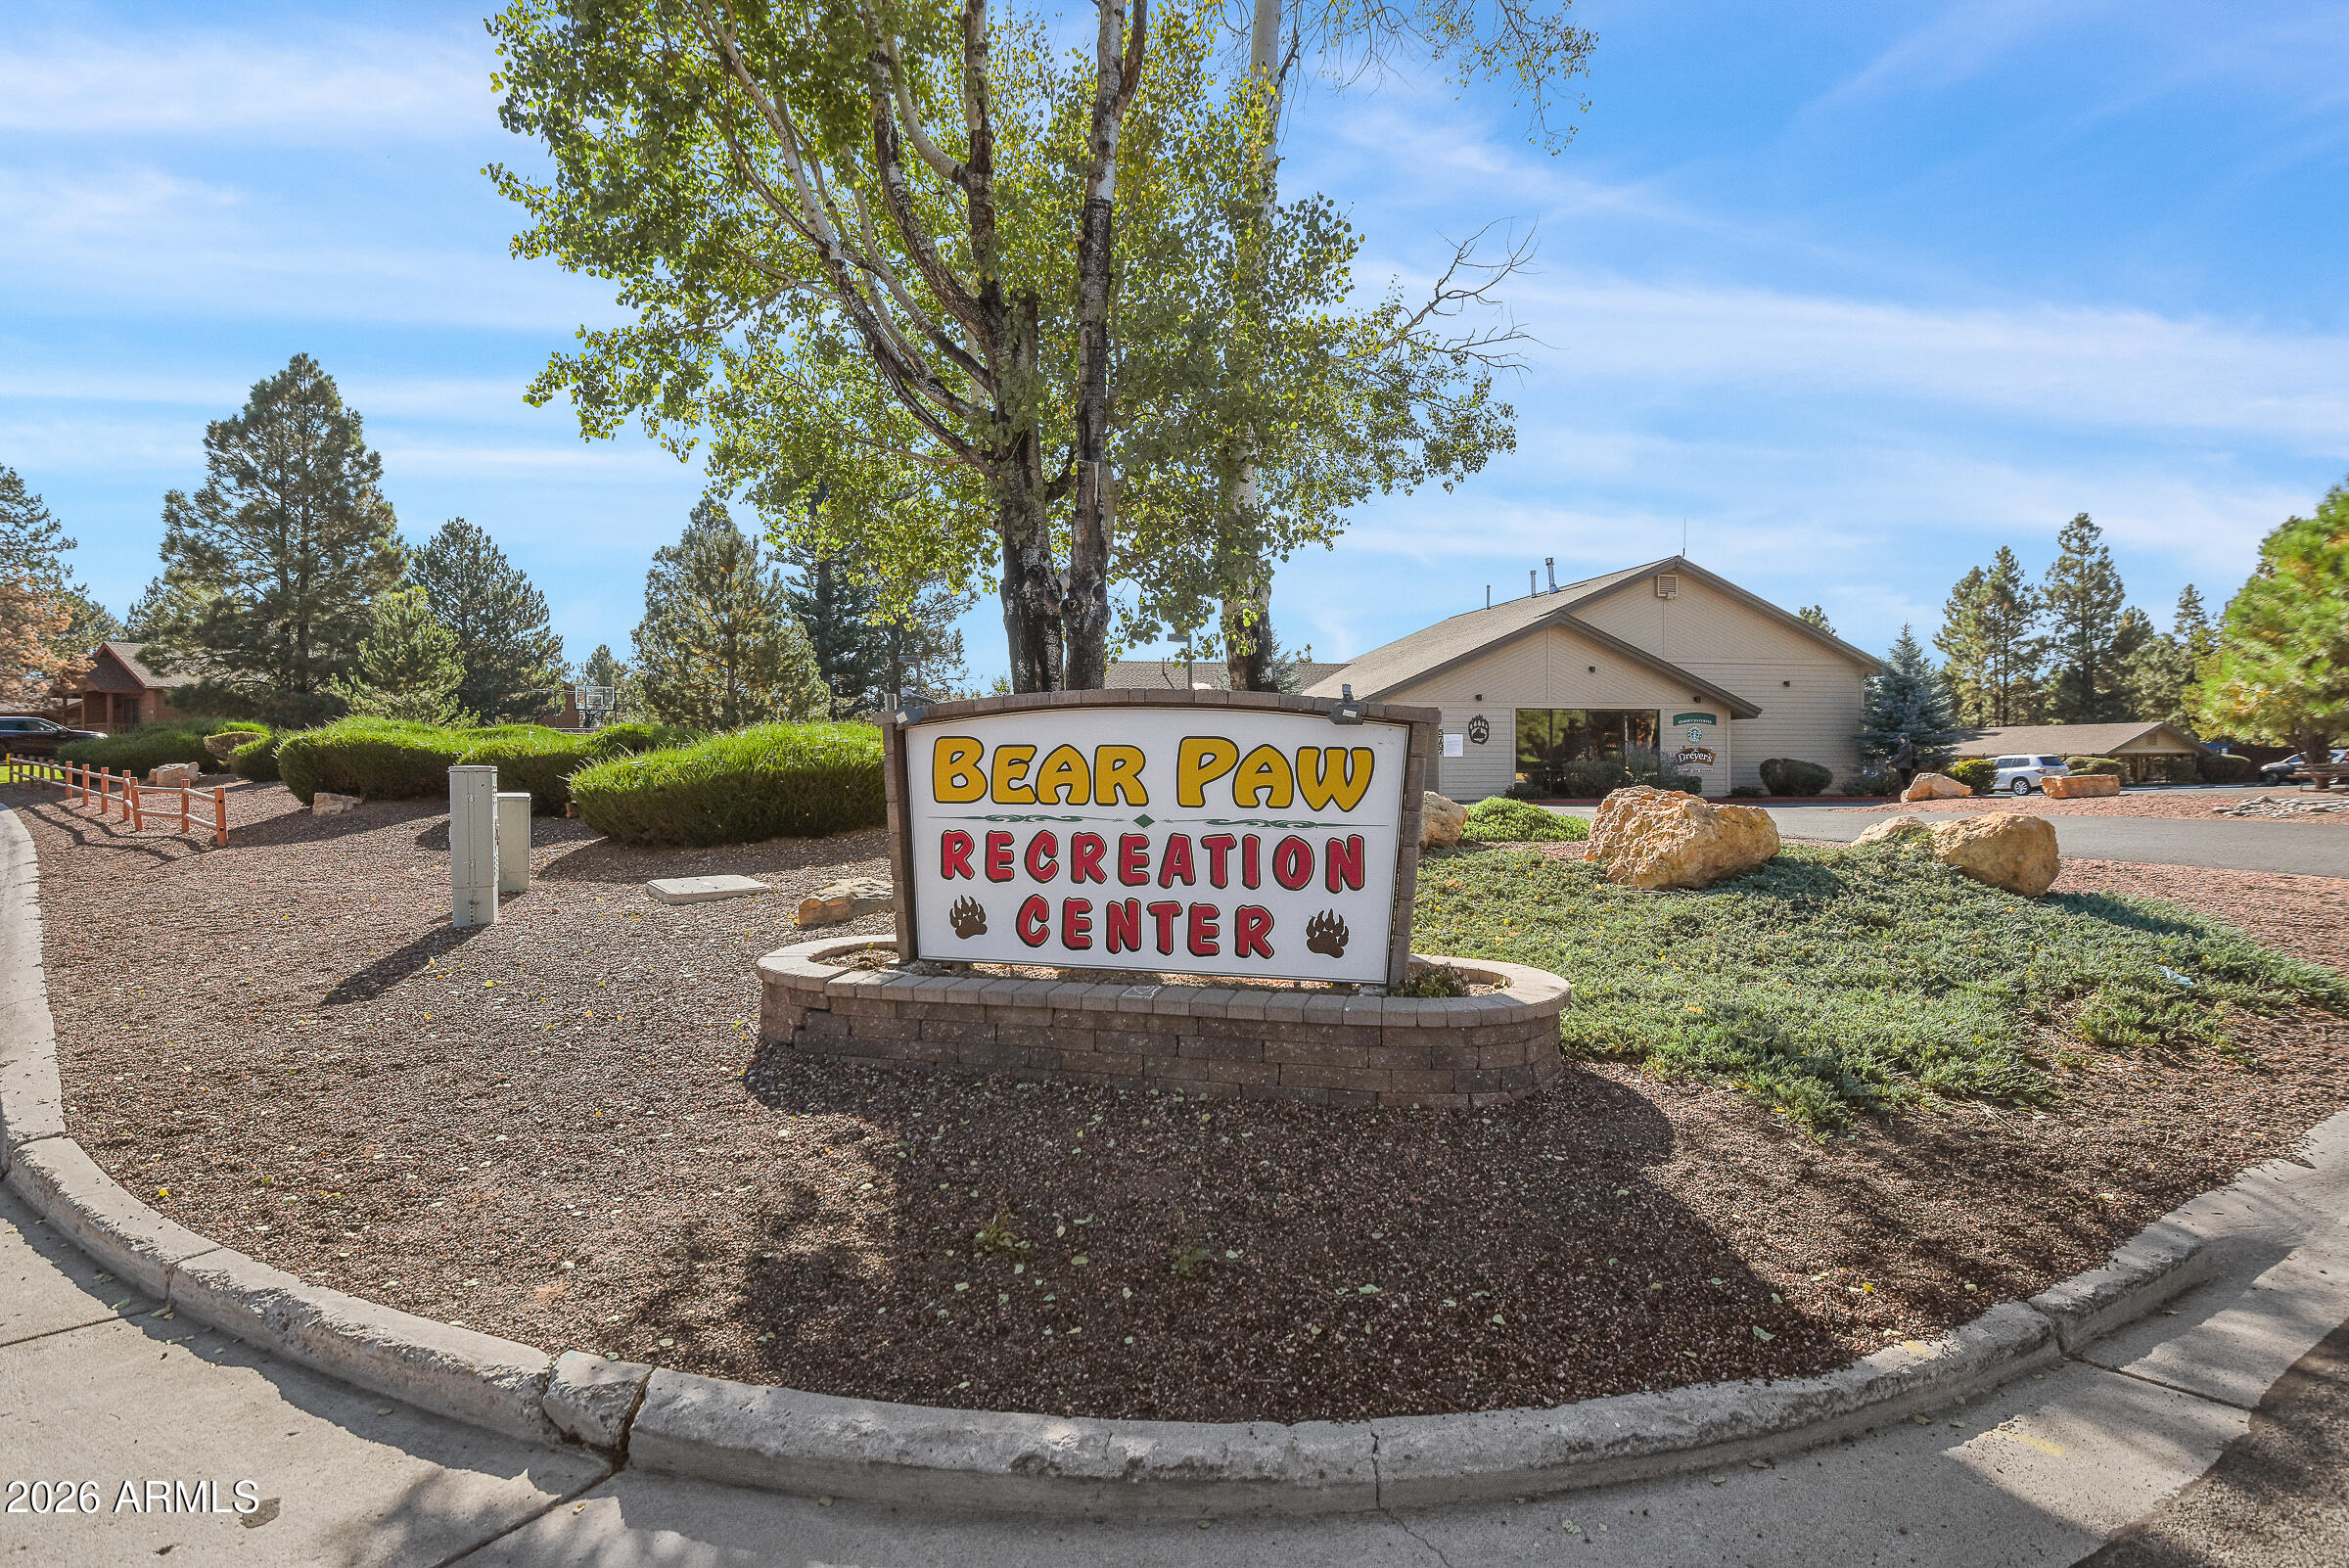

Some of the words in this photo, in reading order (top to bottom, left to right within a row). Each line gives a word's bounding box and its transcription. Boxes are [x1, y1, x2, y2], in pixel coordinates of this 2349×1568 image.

[932, 736, 1149, 807] BEAR
[1176, 736, 1375, 812] PAW
[1678, 752, 1713, 762] Dreyer's
[941, 829, 1365, 894] RECREATION
[1015, 894, 1274, 959] CENTER
